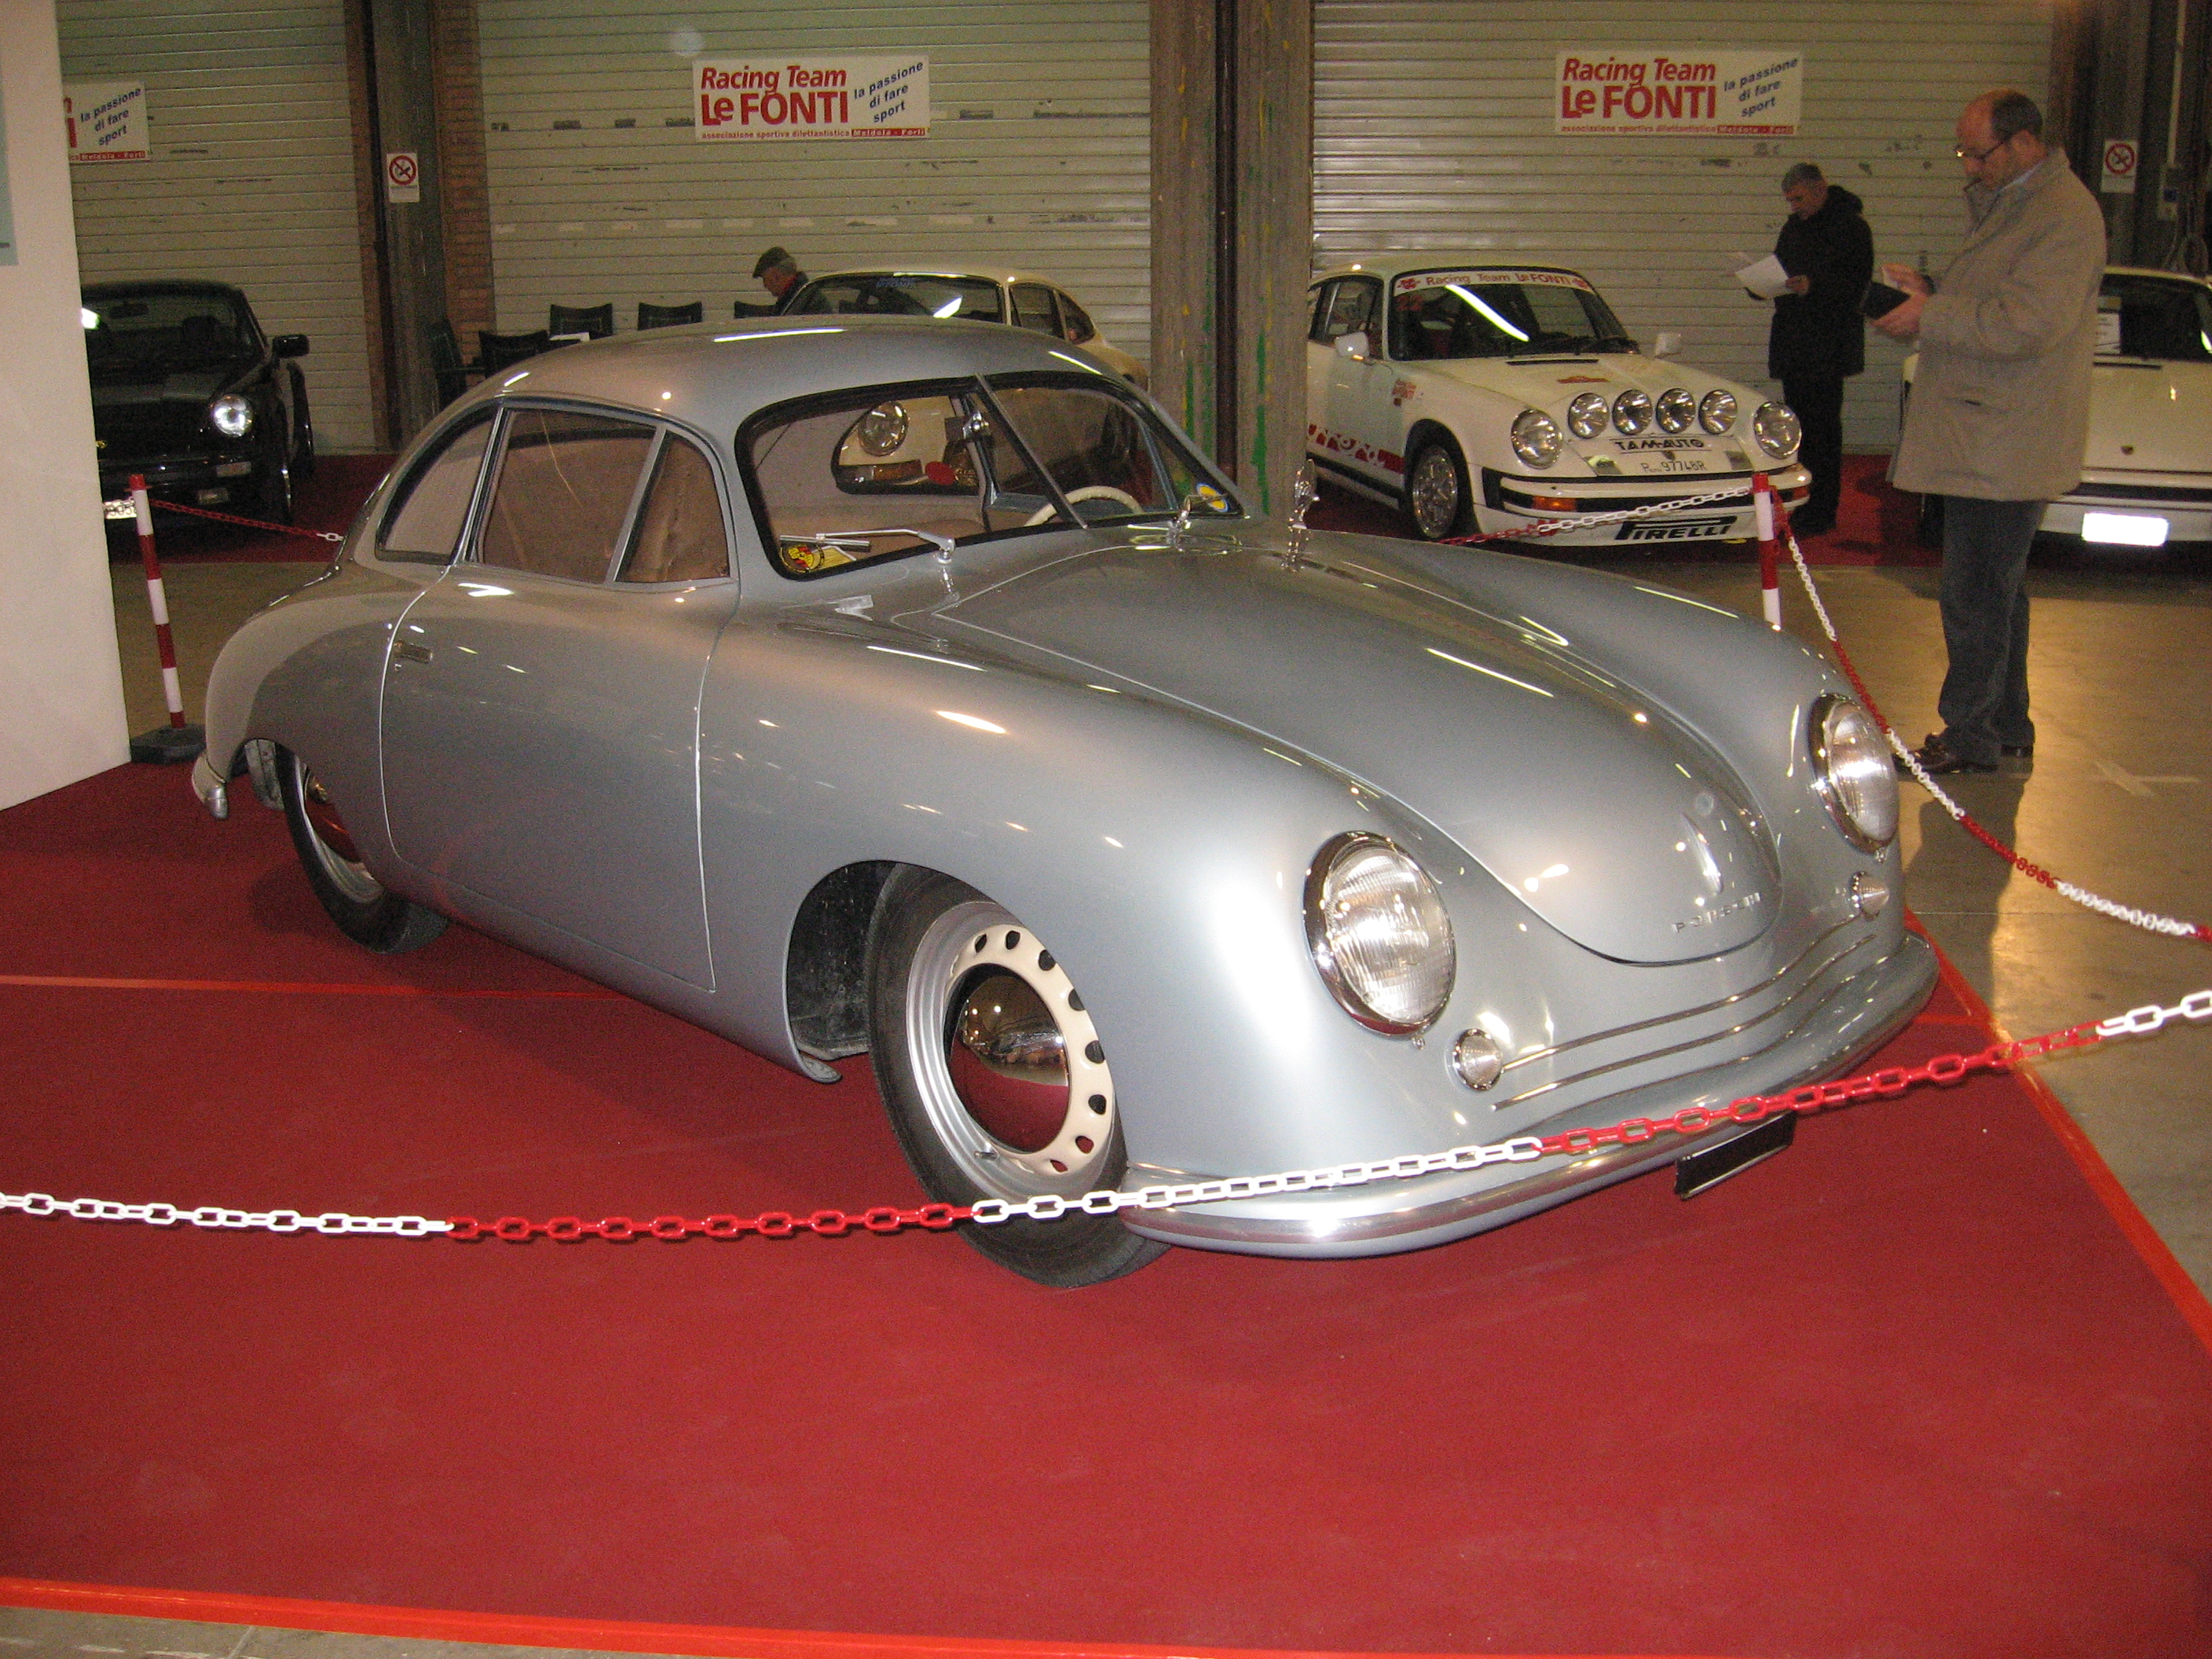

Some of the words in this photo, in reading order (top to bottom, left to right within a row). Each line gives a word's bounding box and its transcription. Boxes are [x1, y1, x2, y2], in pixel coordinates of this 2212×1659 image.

[701, 65, 780, 95] Racing
[786, 64, 848, 88] Team
[854, 88, 865, 99] la
[869, 62, 923, 95] passione
[1562, 57, 1648, 87] Racing
[1654, 58, 1716, 82] Team
[1723, 81, 1736, 92] la
[1739, 58, 1798, 90] passione
[870, 94, 881, 108] di
[884, 85, 909, 102] fare
[1562, 86, 1597, 119] Le
[1602, 85, 1716, 119] FONTI
[1738, 89, 1751, 102] di
[1755, 80, 1781, 96] fare
[80, 112, 91, 123] la
[93, 88, 141, 119] passione
[701, 93, 734, 126] Le
[740, 90, 848, 126] FONTI
[873, 100, 906, 123] sport
[1741, 97, 1776, 117] sport
[94, 119, 105, 132] di
[108, 110, 129, 125] fare
[98, 125, 127, 145] sport
[1426, 273, 1470, 286] Racing
[1477, 273, 1511, 283] Team
[1614, 515, 1738, 540] PIRELLI
